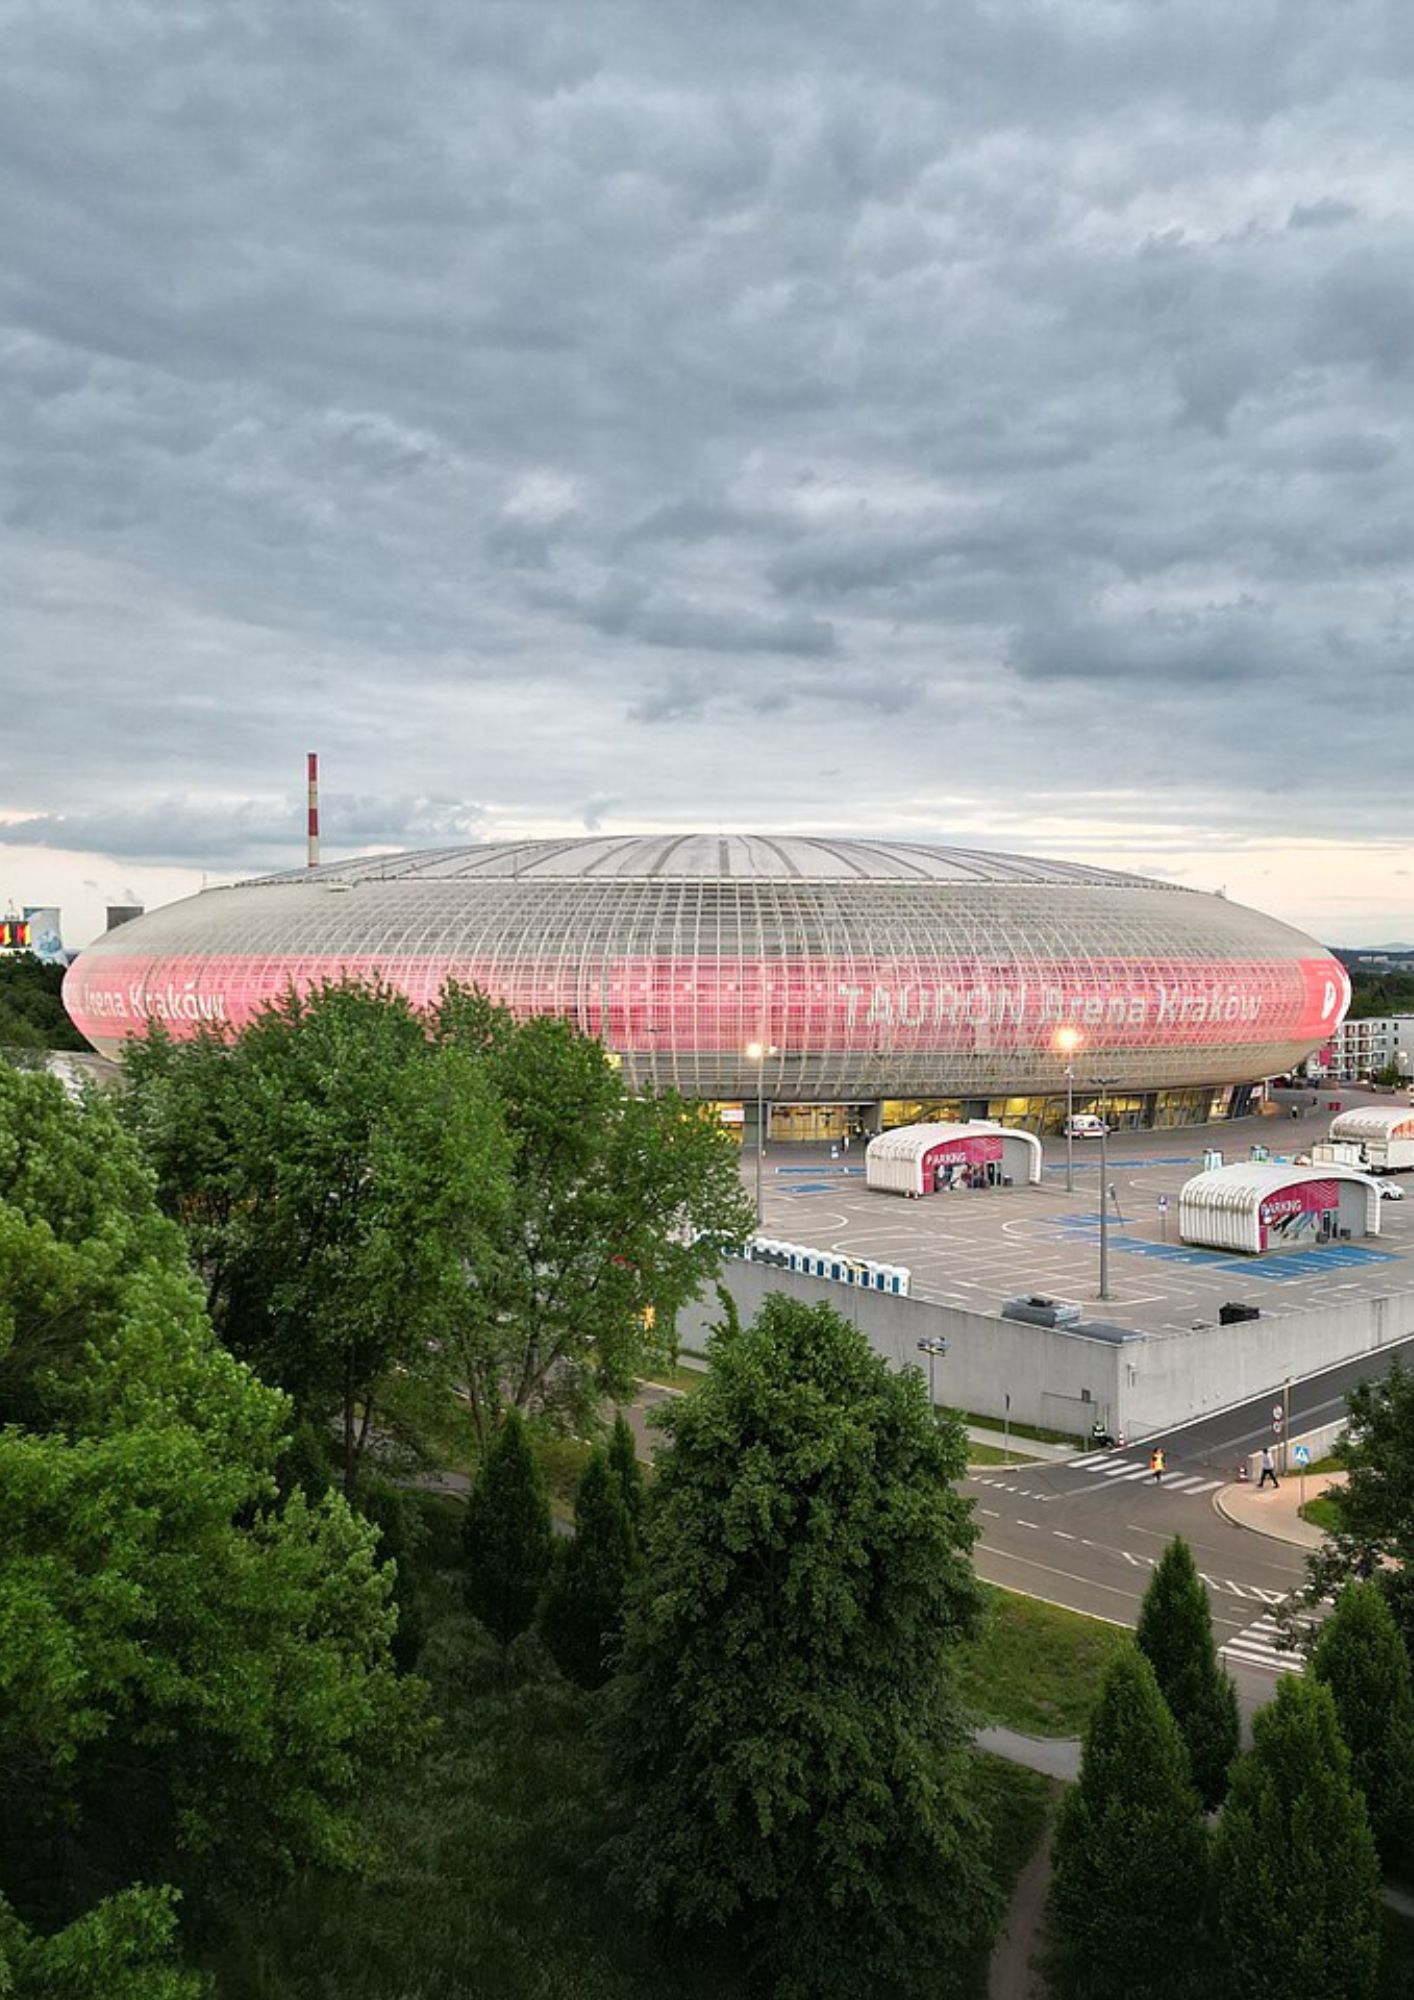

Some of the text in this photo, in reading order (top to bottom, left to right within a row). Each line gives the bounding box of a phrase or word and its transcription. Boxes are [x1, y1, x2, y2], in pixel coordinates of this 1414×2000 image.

[838, 983, 1263, 1025] TAURON Arena Kraków
[926, 1152, 966, 1165] PARKING
